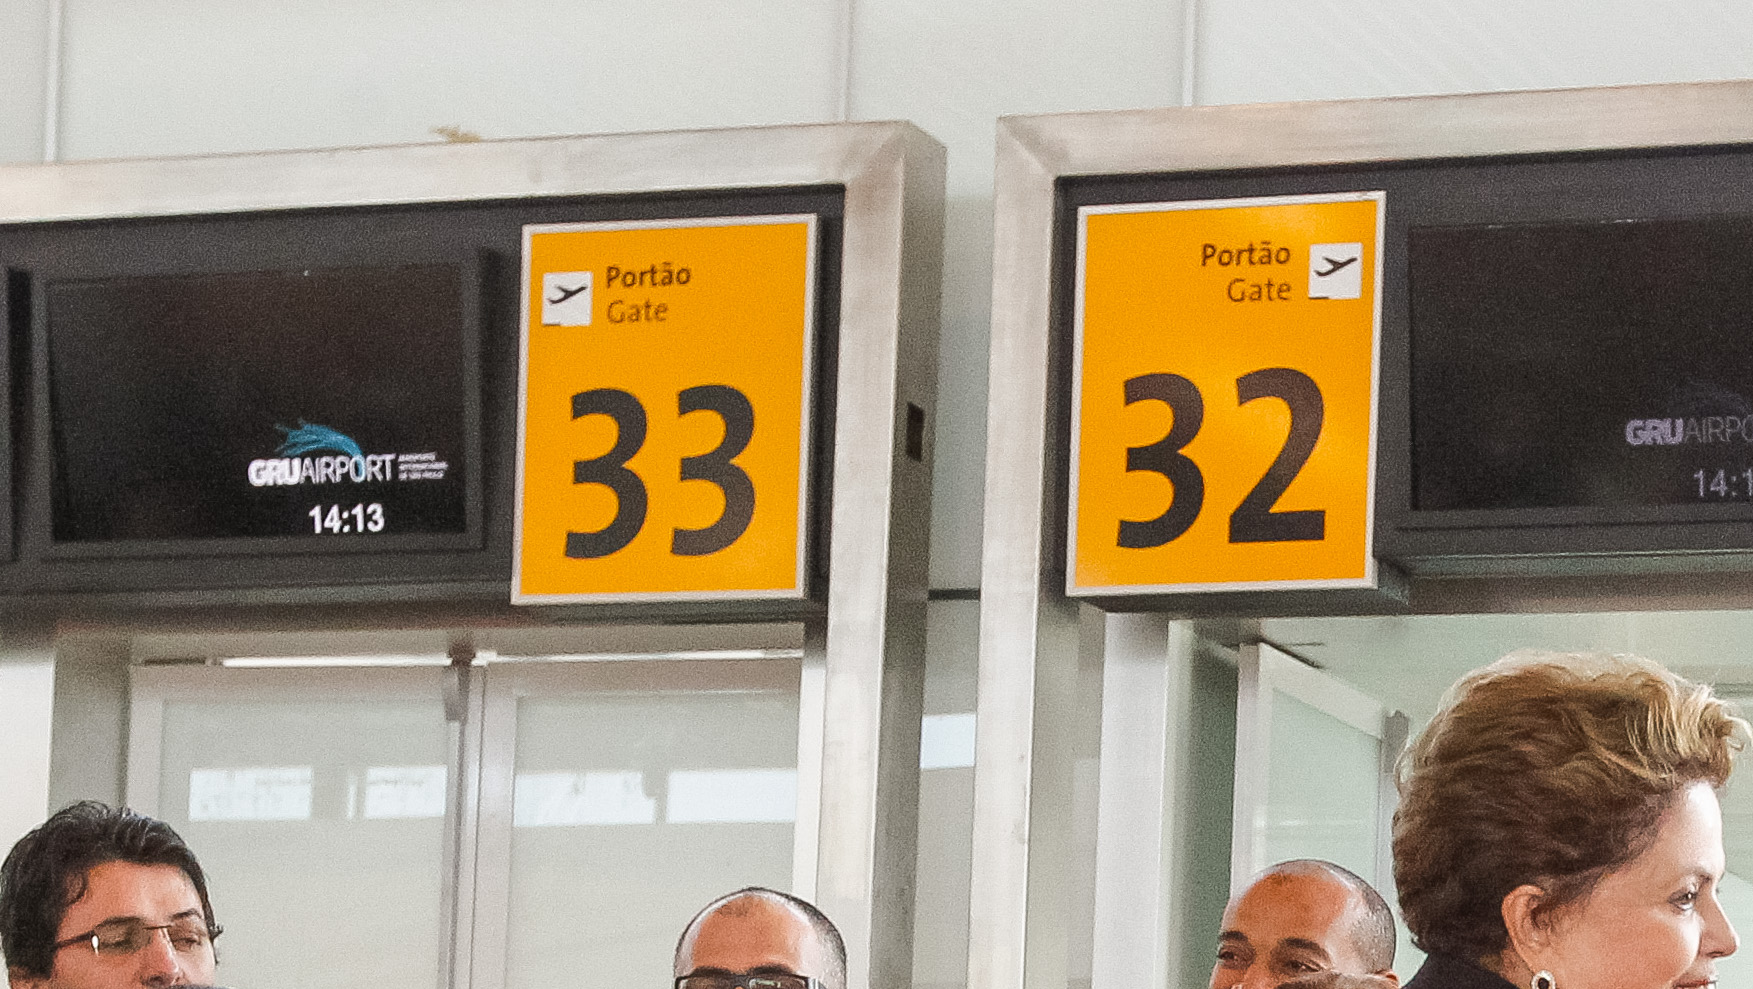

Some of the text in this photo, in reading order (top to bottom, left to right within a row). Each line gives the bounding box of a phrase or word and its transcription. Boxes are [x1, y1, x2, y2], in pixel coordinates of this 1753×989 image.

[1201, 240, 1291, 268] Portão
[605, 261, 692, 289] Portão
[1227, 277, 1292, 303] Gate
[607, 298, 669, 324] Gate
[564, 384, 756, 559] 33
[1115, 367, 1327, 549] 32
[308, 502, 386, 534] 14:13
